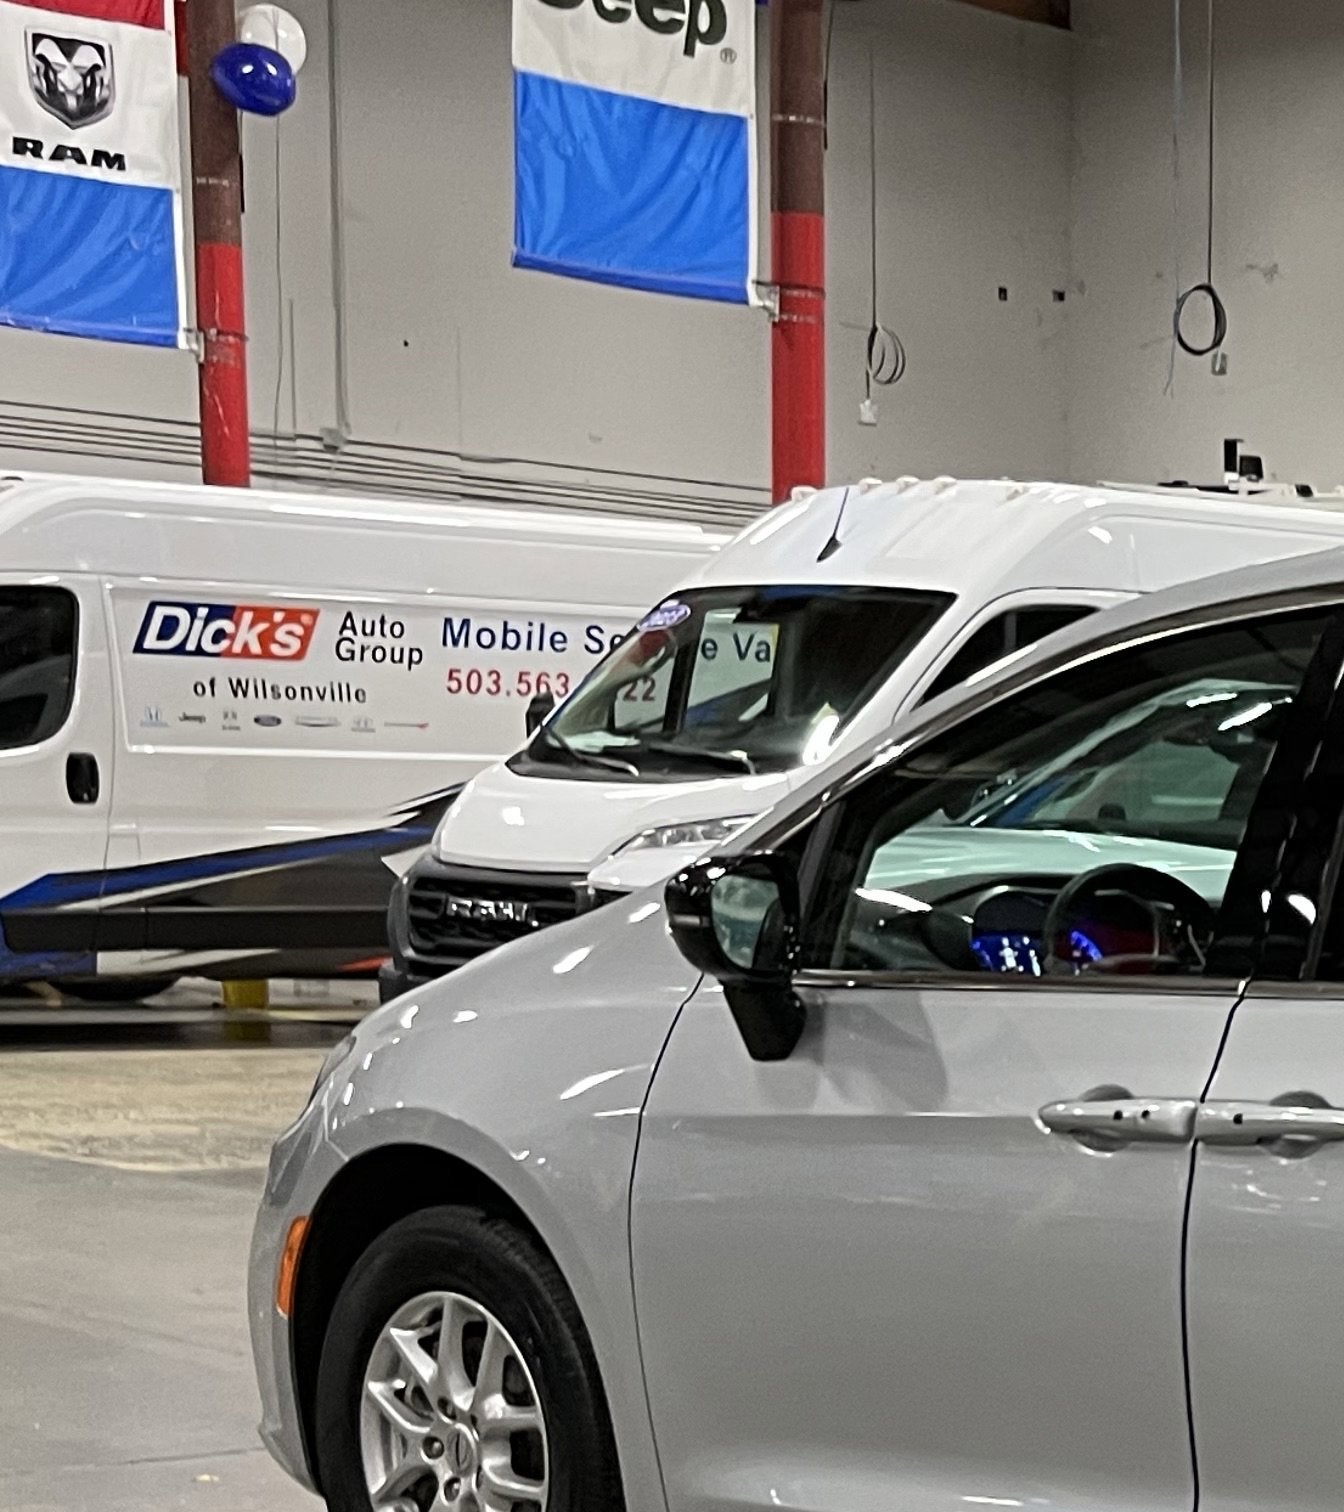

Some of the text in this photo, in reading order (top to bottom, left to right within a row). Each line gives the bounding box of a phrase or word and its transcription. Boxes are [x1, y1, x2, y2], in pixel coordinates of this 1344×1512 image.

[12, 136, 127, 171] RAM
[143, 605, 305, 657] Dick's
[338, 611, 406, 640] Auto
[442, 616, 569, 652] Mobile
[334, 636, 424, 672] Group
[192, 676, 368, 704] of Wilsonville
